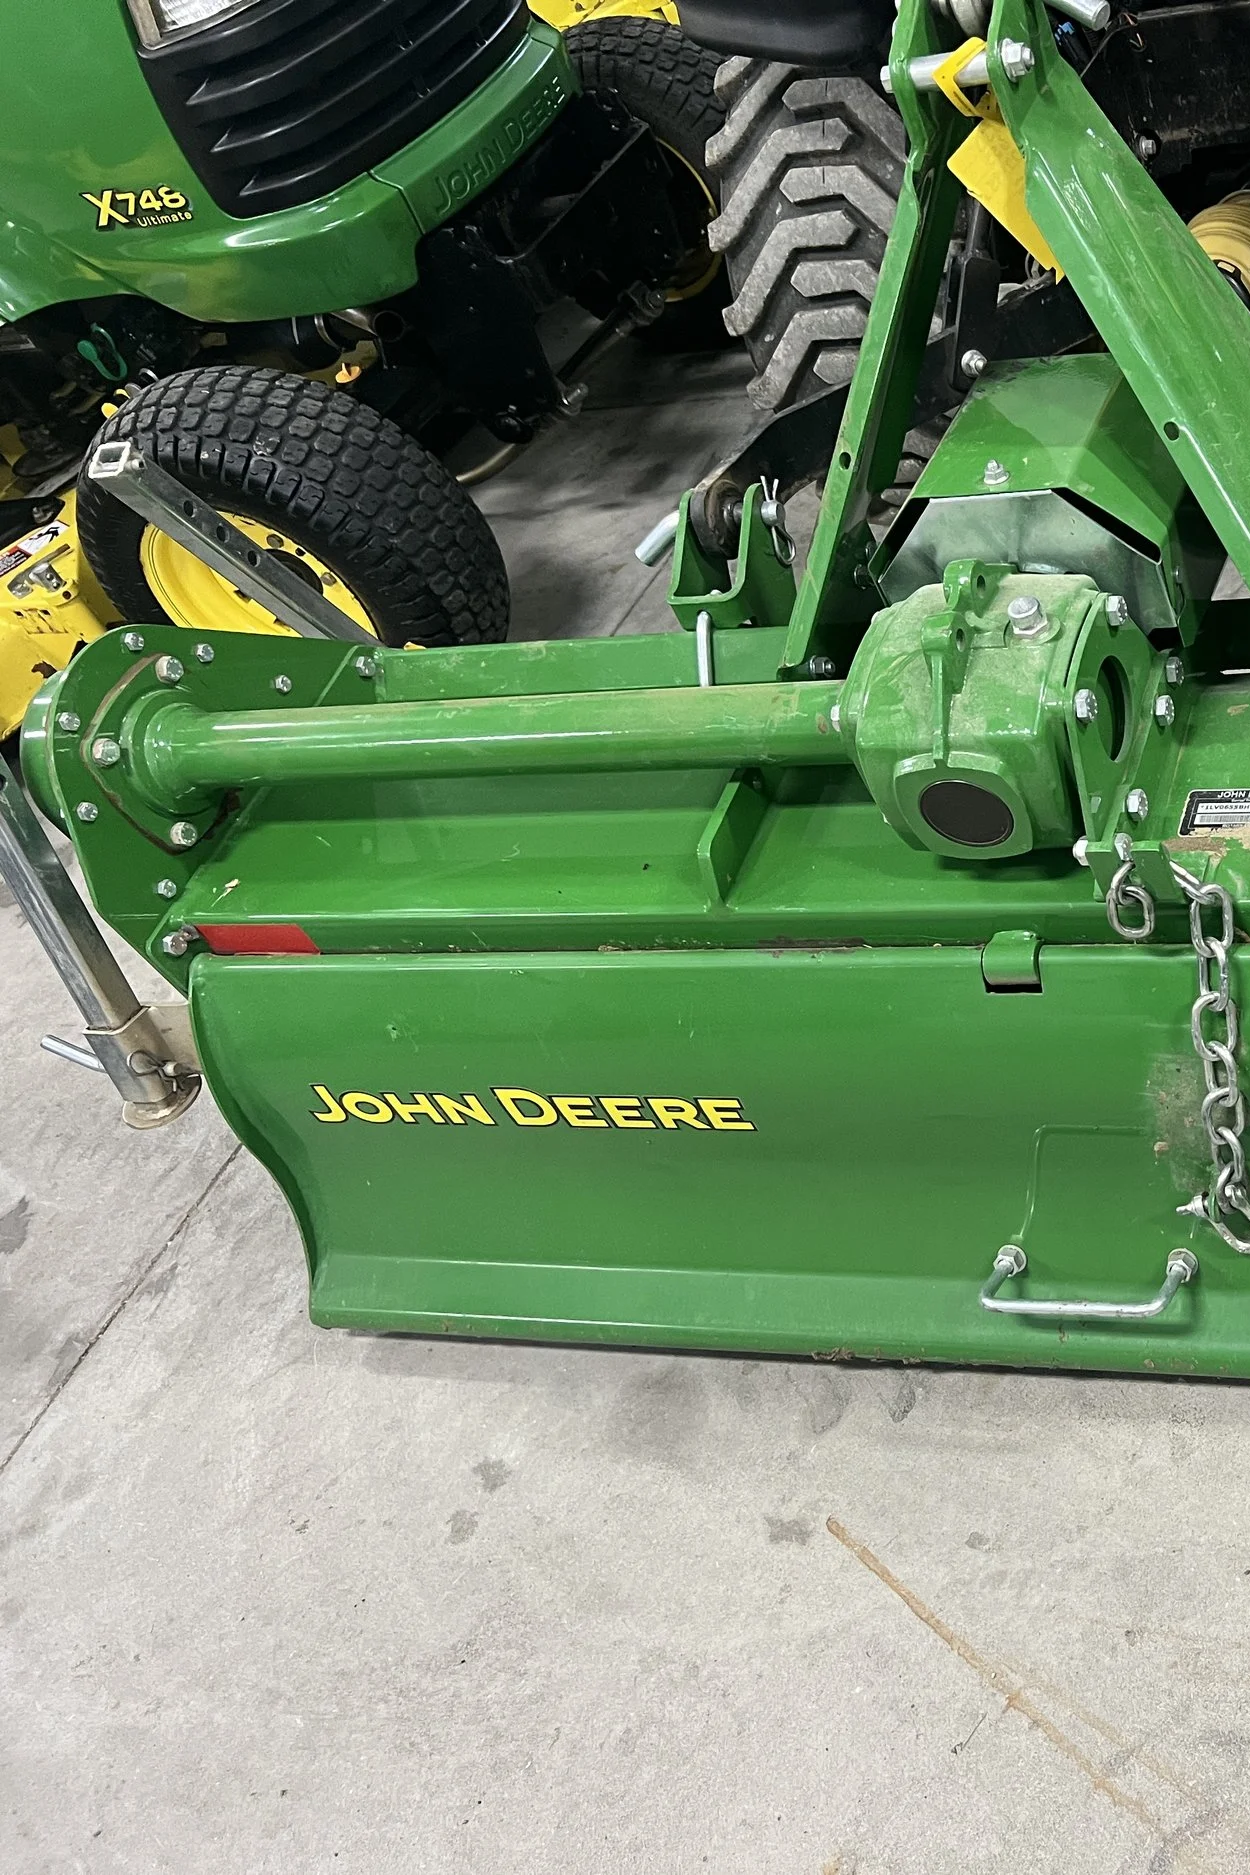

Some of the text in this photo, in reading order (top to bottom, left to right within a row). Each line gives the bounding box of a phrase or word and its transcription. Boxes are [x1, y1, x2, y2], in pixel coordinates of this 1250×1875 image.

[435, 138, 506, 216] JOHN
[80, 184, 188, 229] X748
[136, 210, 193, 228] Ultimate
[1217, 790, 1246, 799] JOHN
[309, 1084, 759, 1133] JOHN DEERE
